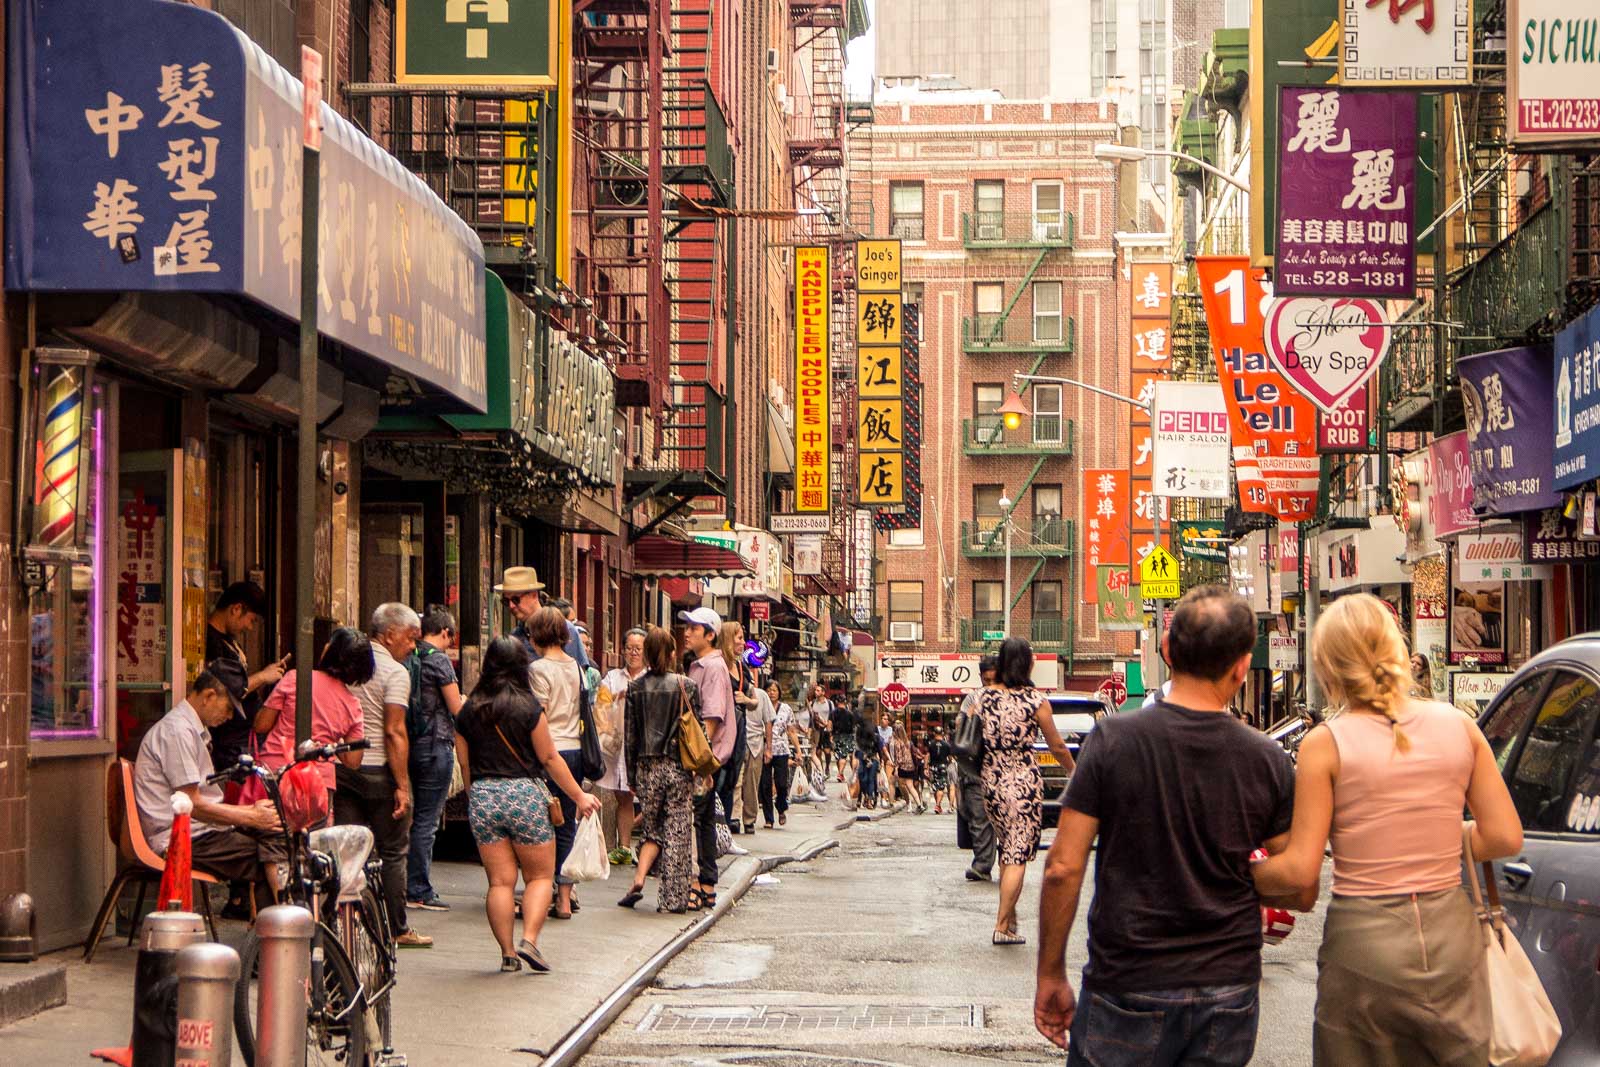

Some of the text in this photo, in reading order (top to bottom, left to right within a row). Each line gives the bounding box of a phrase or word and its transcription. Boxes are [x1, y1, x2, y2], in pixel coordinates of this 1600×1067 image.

[84, 92, 145, 250] 中華
[157, 62, 222, 273] 髮型屋
[1283, 219, 1408, 245] 美容美髮中心
[865, 247, 893, 262] Joe's
[1320, 250, 1347, 268] Beauty
[1349, 254, 1357, 265] &
[1358, 250, 1379, 265] Hair
[1381, 251, 1406, 266] Salon
[859, 266, 899, 284] Ginger
[801, 259, 823, 425] HANDPULLED NOODLES
[1286, 351, 1368, 374] Day Spa
[860, 298, 900, 498] 錦江飯店
[1234, 378, 1280, 404] Le
[1160, 411, 1226, 433] PELL
[1322, 410, 1365, 426] FOOT
[1159, 433, 1228, 443] HAIR SALON
[1327, 428, 1360, 444] RUB
[1146, 584, 1175, 594] AHEAD
[883, 690, 909, 702] STOP
[179, 1023, 210, 1045] ABOVE
